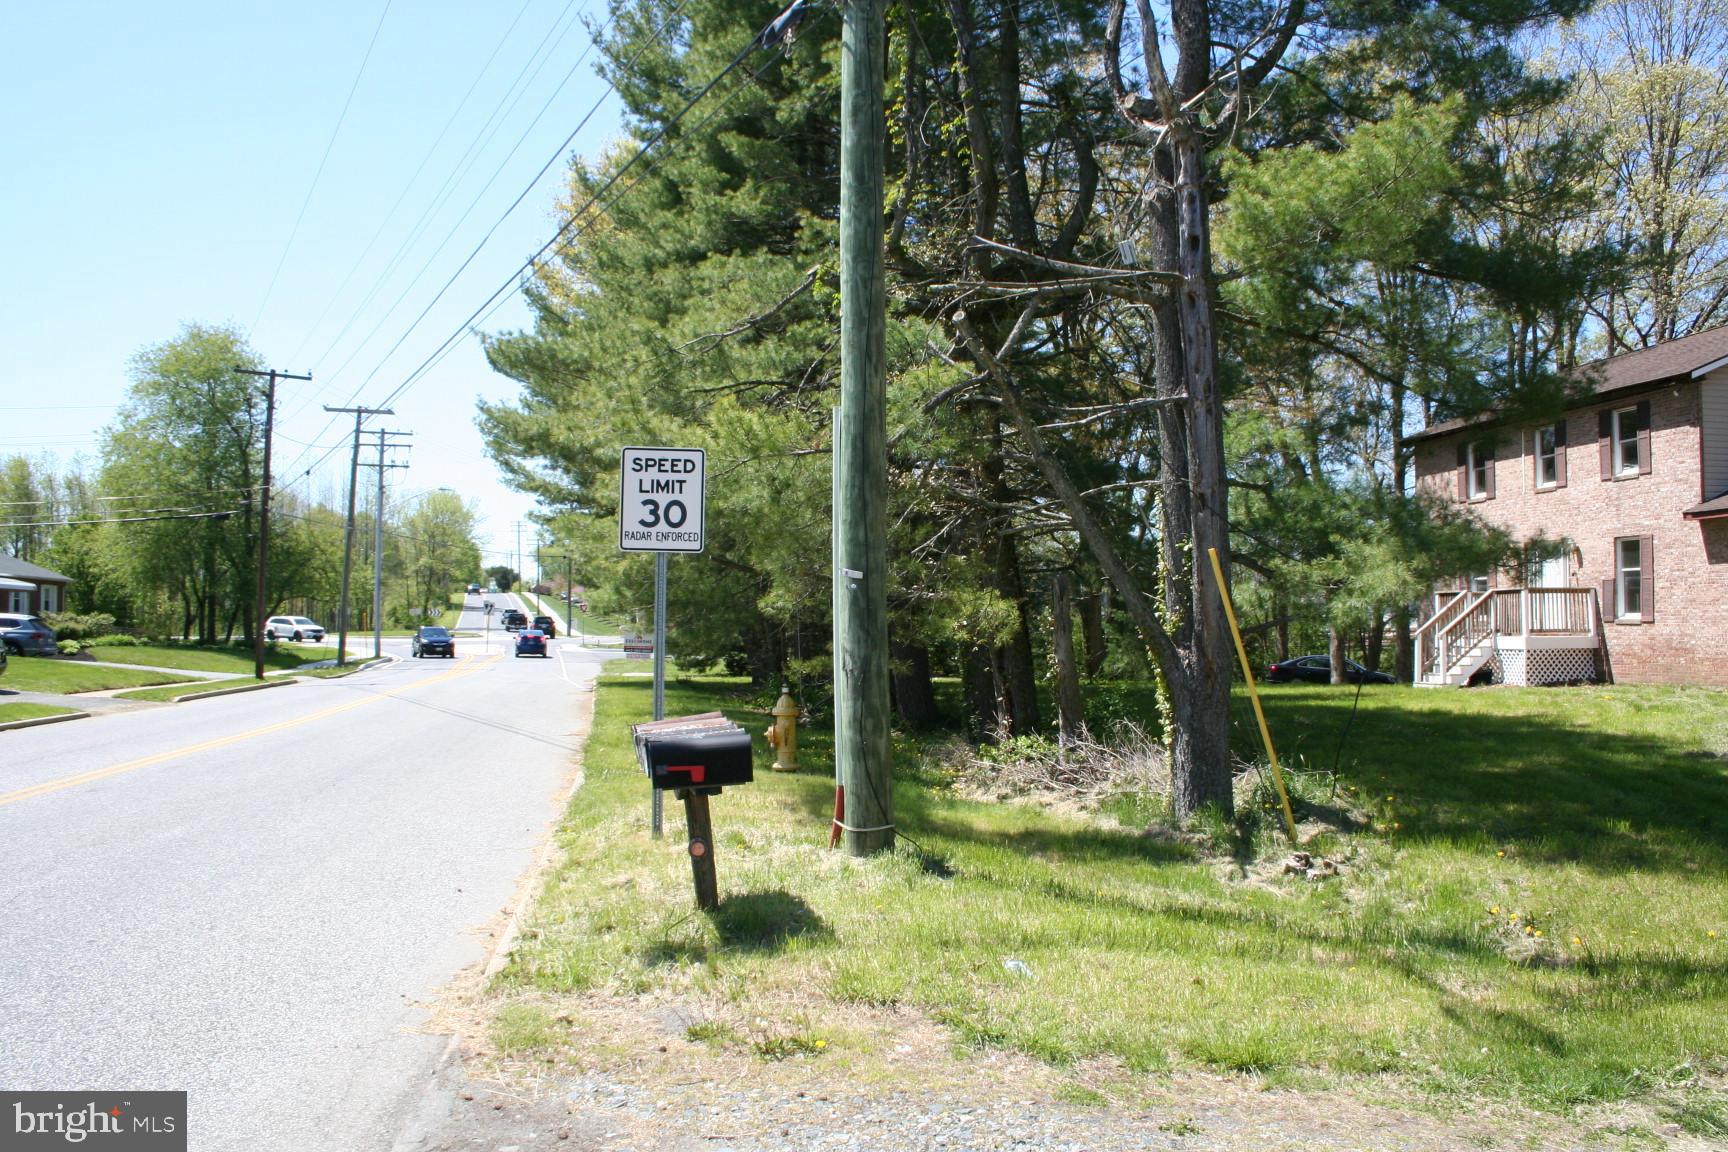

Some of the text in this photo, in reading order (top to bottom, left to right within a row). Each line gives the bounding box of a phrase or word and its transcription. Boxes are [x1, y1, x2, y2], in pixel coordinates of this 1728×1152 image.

[632, 457, 695, 473] SPEED
[639, 479, 687, 494] LIMIT
[638, 499, 687, 528] 30
[624, 530, 699, 542] RADAR ENFORCED
